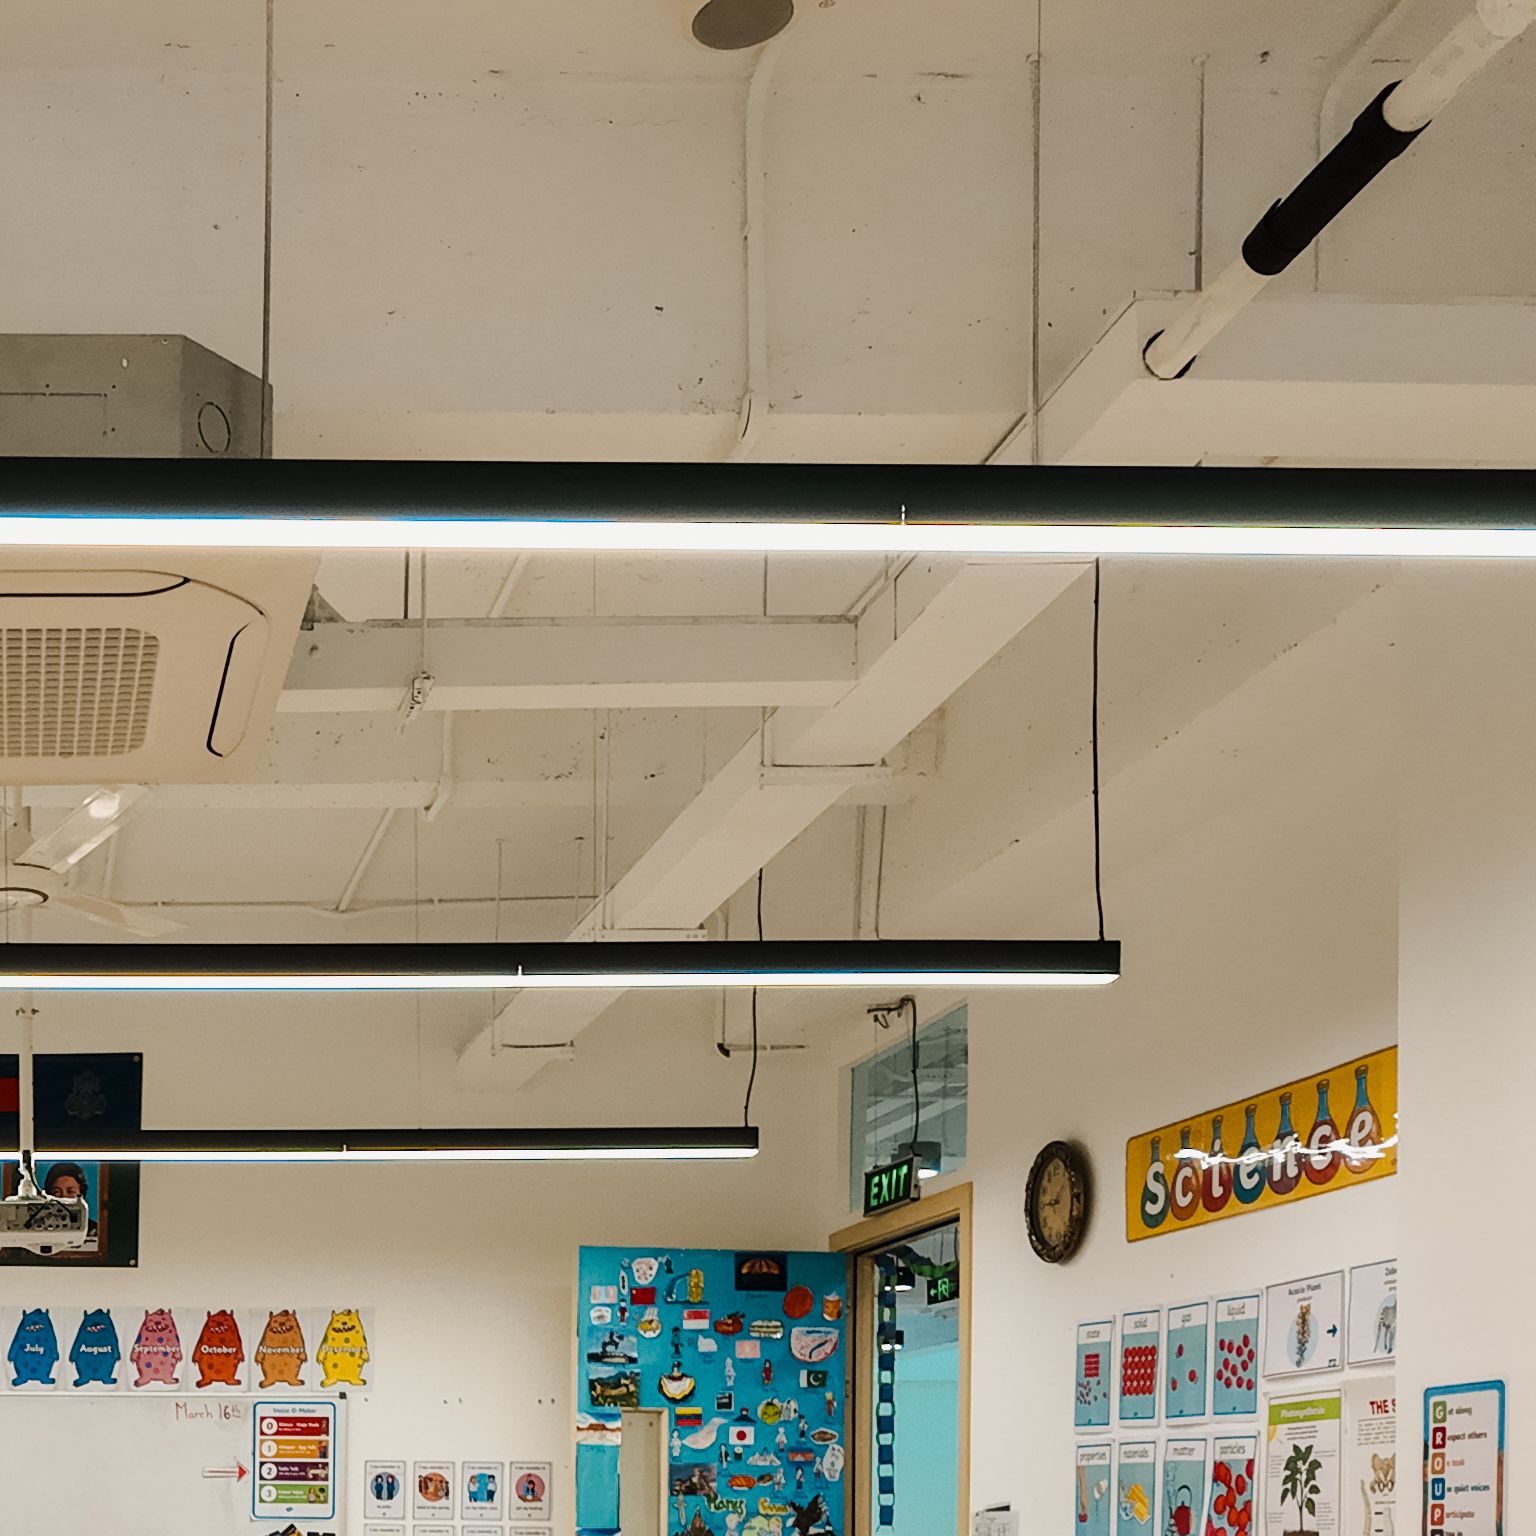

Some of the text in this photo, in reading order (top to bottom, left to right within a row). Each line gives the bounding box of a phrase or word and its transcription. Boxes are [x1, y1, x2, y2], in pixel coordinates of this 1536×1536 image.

[870, 1165, 908, 1207] EXIT
[23, 1343, 45, 1355] July
[79, 1344, 112, 1355] August
[133, 1344, 180, 1354] September
[200, 1345, 236, 1353] October
[258, 1345, 304, 1354] November
[175, 1402, 213, 1421] March
[1369, 1400, 1389, 1415] THE
[266, 1467, 273, 1475] 2
